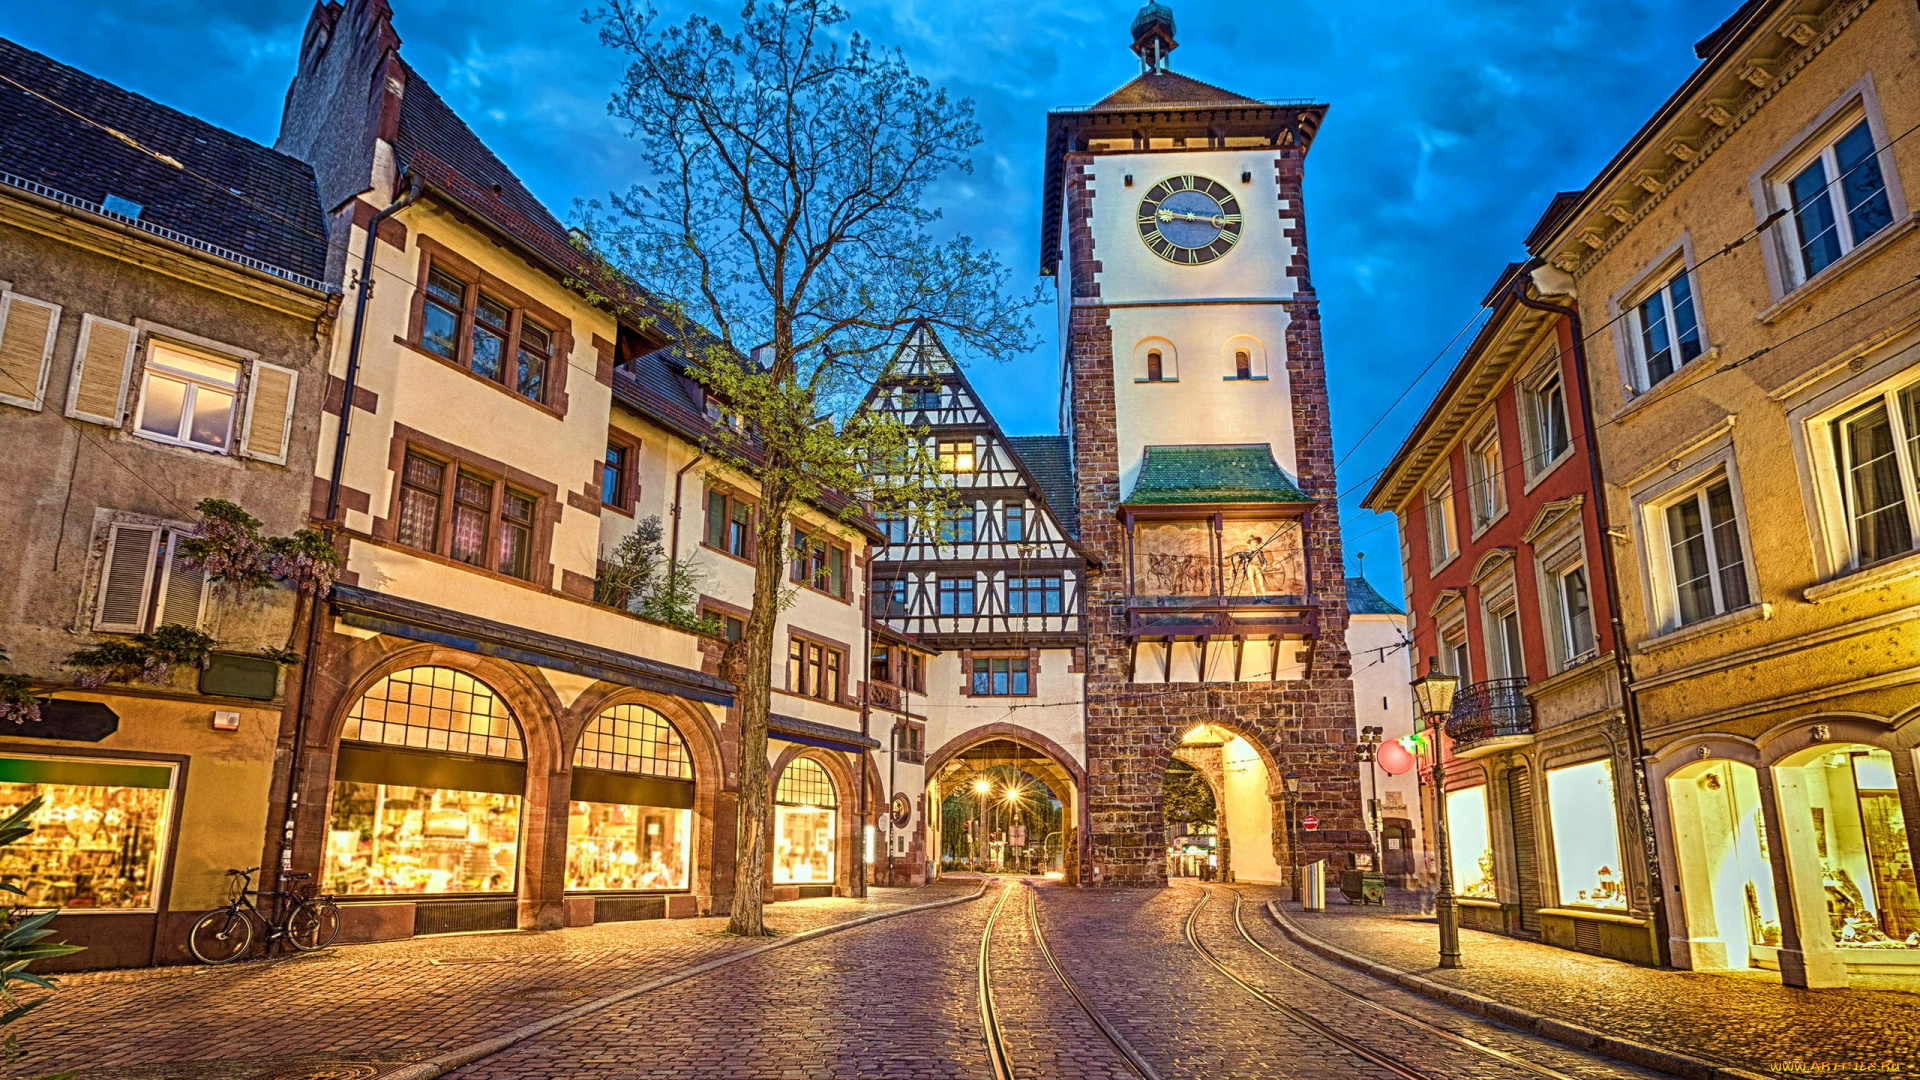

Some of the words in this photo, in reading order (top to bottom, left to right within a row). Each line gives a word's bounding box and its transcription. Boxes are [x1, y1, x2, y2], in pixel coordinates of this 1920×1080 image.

[1158, 179, 1174, 196] XI
[1181, 175, 1194, 189] XII
[1205, 180, 1214, 193] I
[1143, 195, 1160, 206] X
[1218, 194, 1234, 205] II
[1138, 215, 1156, 224] IX
[1224, 214, 1241, 222] III
[1143, 229, 1163, 248] VIII
[1161, 243, 1177, 260] VII
[1188, 248, 1199, 263] VI
[1209, 245, 1221, 259] V
